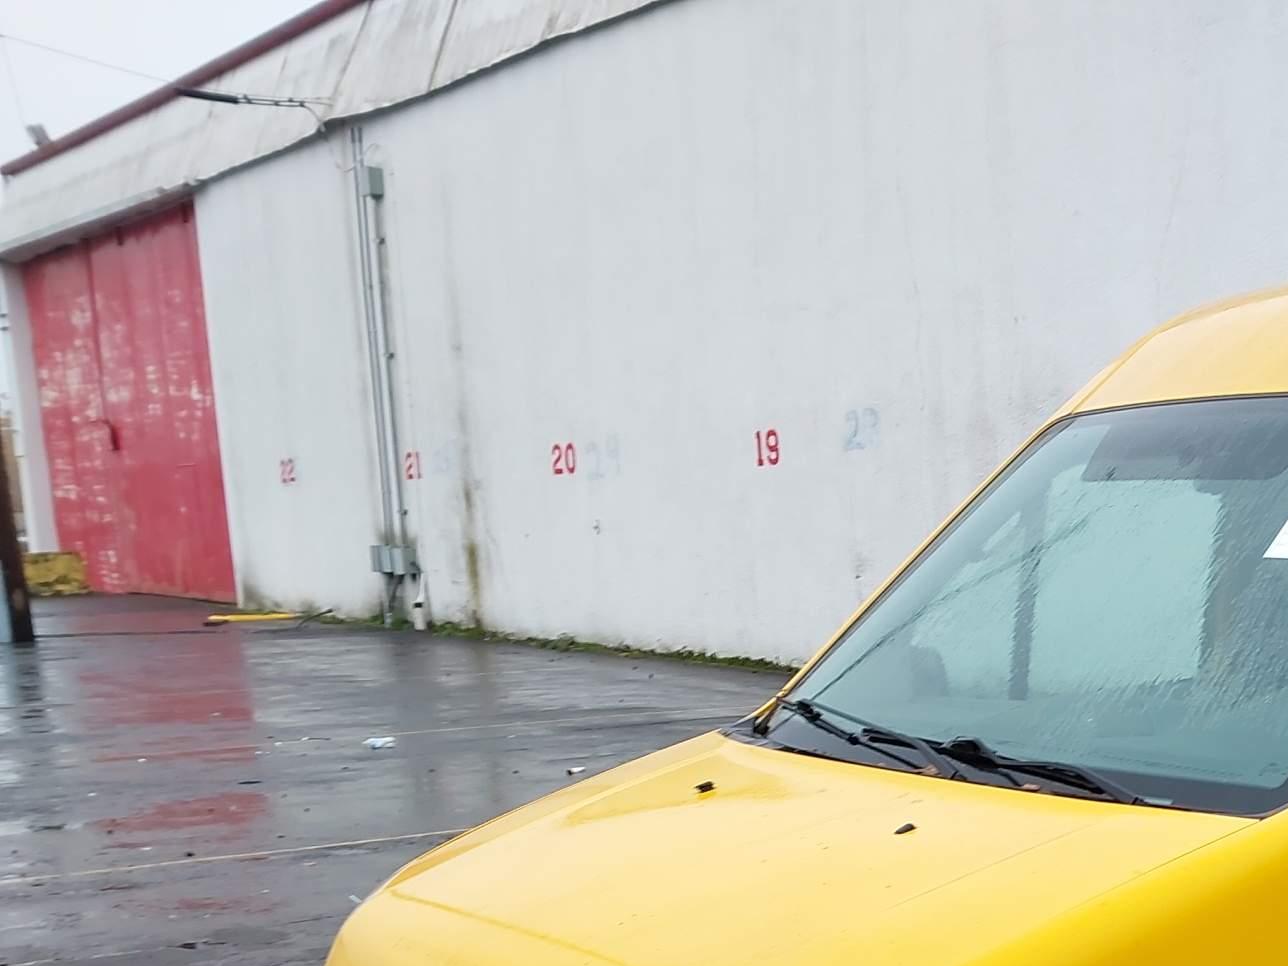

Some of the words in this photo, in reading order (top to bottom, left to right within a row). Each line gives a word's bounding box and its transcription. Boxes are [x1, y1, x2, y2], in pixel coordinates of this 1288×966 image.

[551, 443, 577, 475] 20
[756, 430, 779, 466] 19
[405, 452, 421, 480] 21
